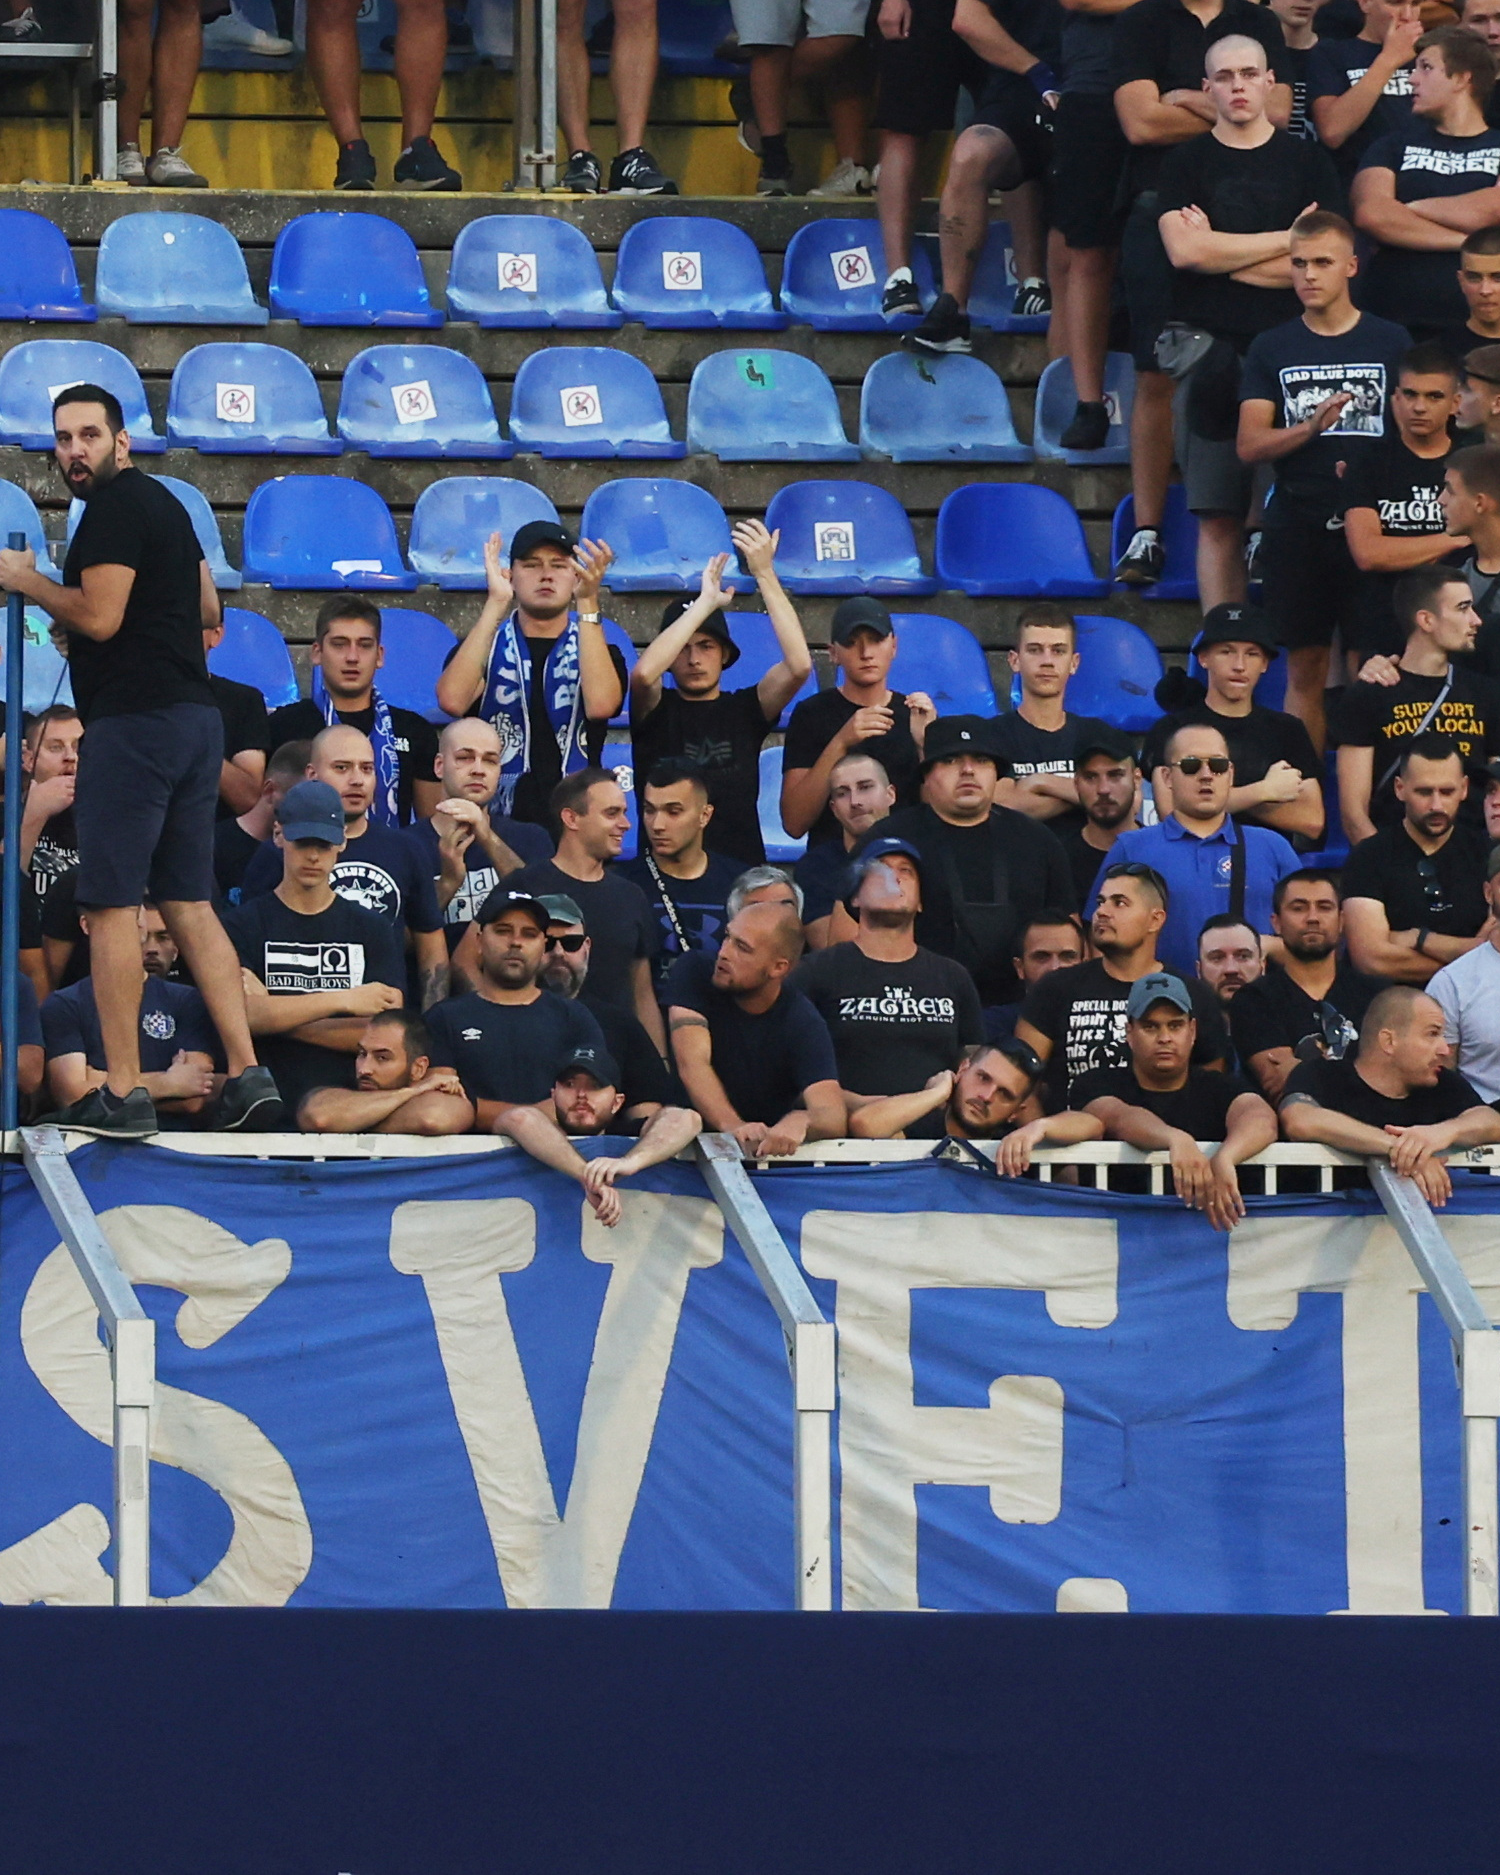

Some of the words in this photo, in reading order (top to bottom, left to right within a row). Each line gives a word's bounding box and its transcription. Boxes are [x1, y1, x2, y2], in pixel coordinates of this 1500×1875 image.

[1405, 145, 1431, 157] BAD
[1467, 146, 1500, 157] BOYS
[1400, 154, 1500, 178] ZAGREB
[1284, 371, 1310, 383] BAD
[1311, 370, 1344, 382] BLUE
[1345, 369, 1379, 380] BOYS
[1392, 701, 1476, 721] SUPORT
[1036, 760, 1066, 773] BLUE
[337, 866, 367, 880] BLUE
[367, 869, 394, 895] BOYS
[267, 975, 292, 987] BAD
[293, 975, 318, 988] BLUE
[320, 976, 350, 989] BOYS
[839, 990, 955, 1017] ZAGREB
[1071, 1000, 1109, 1012] SPECIAL
[1065, 1028, 1106, 1043] LIKE
